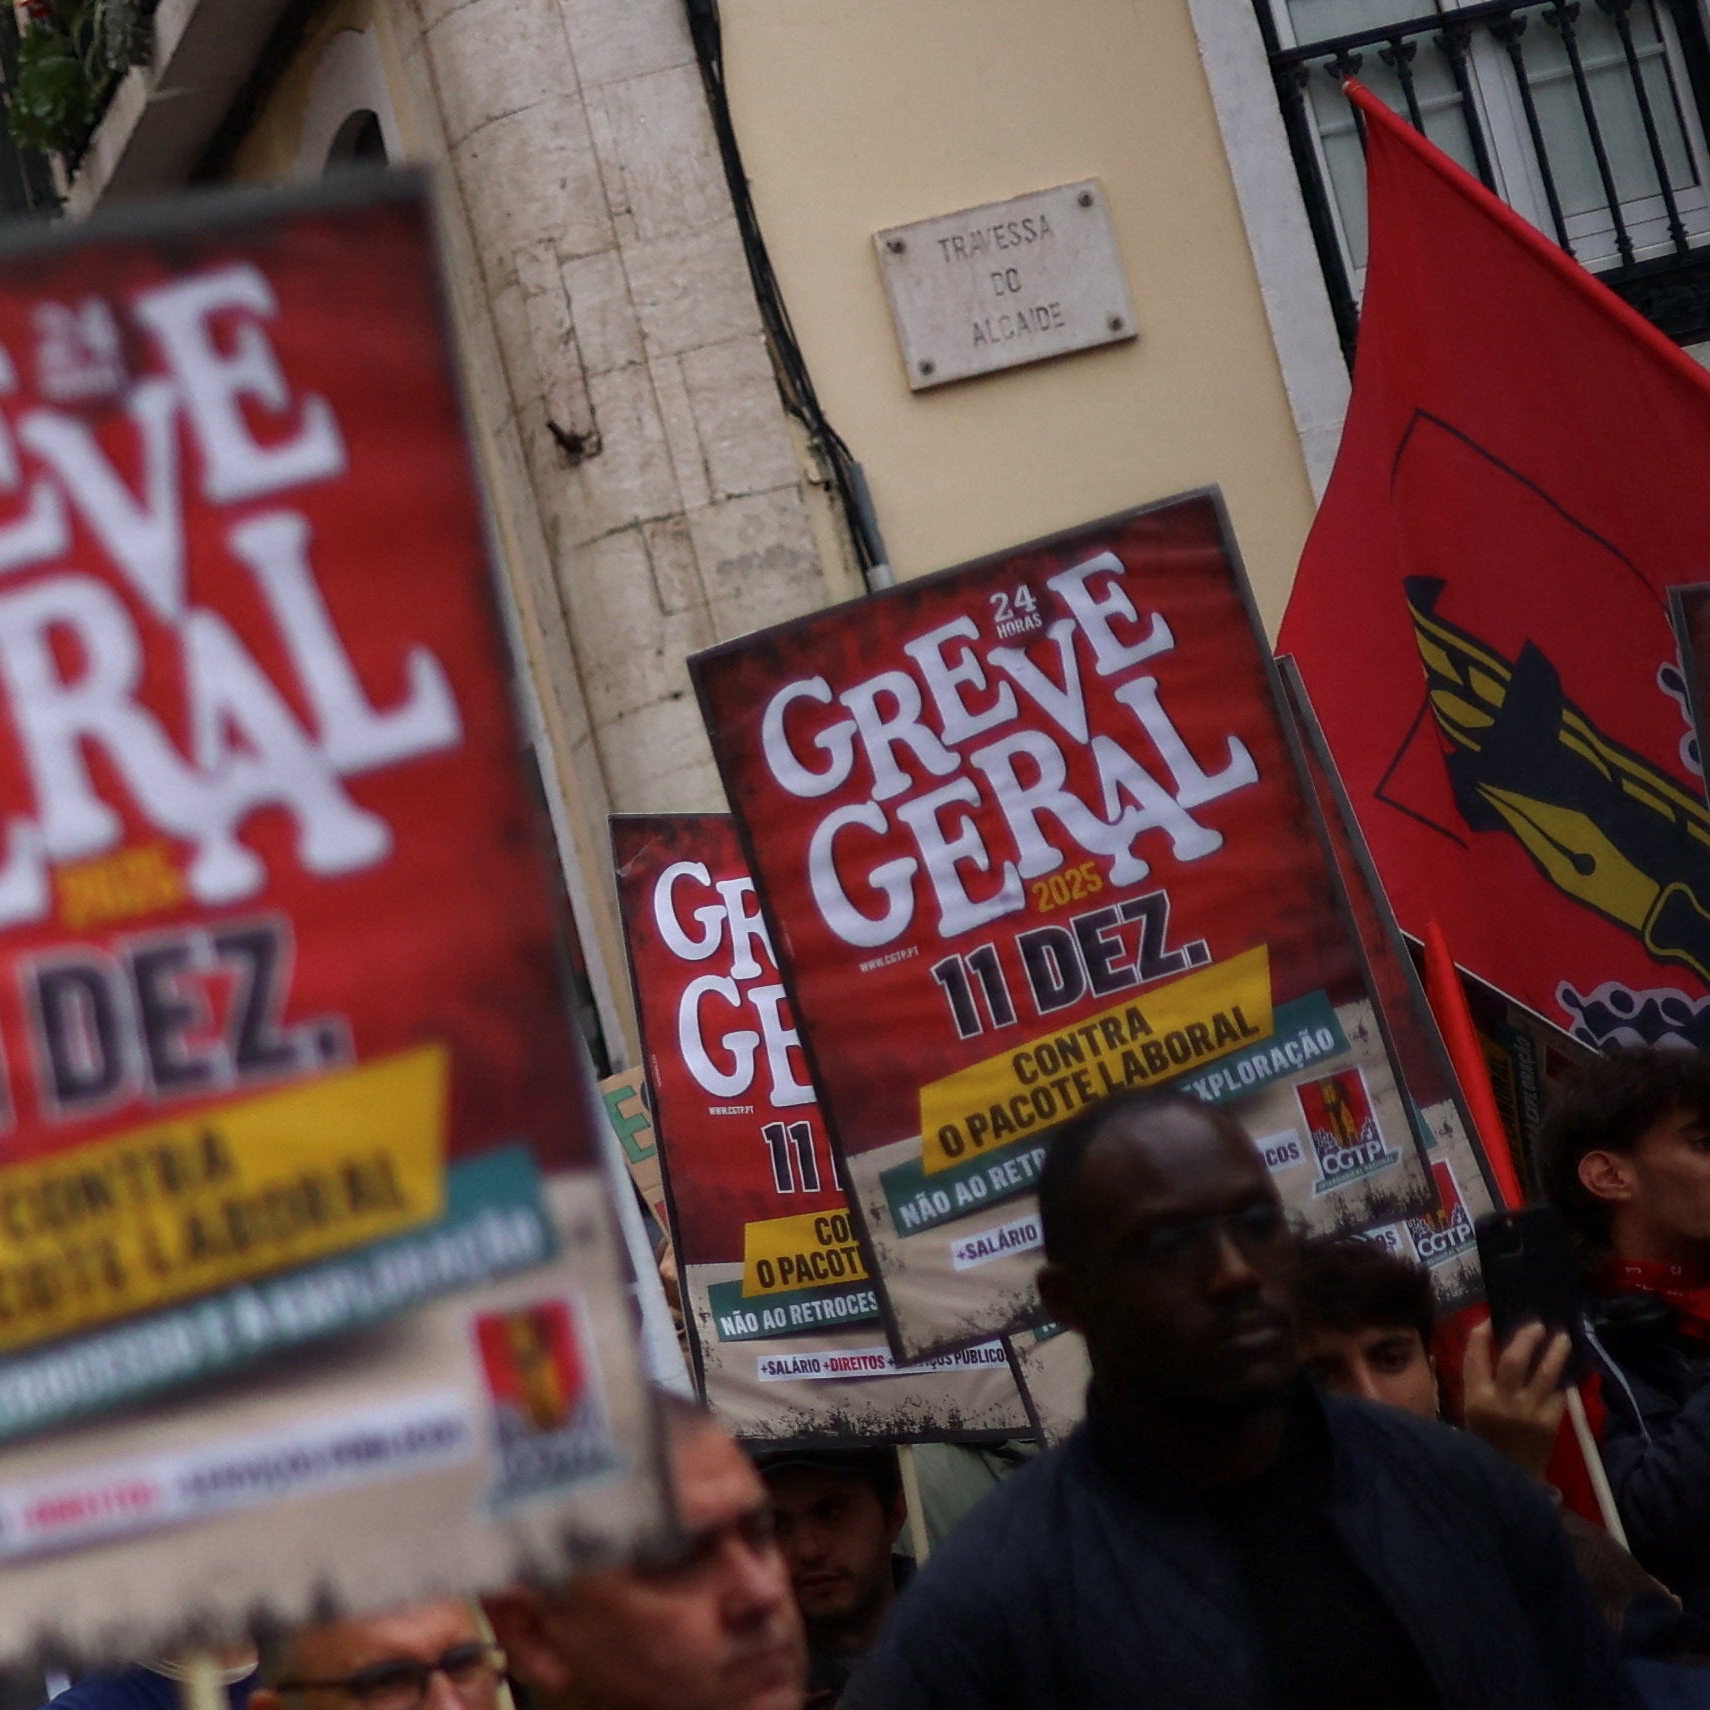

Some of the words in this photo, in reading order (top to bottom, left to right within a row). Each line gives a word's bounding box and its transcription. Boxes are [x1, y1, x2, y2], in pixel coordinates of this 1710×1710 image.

[937, 214, 1054, 264] TRAVESSA
[990, 268, 1020, 297] DO
[972, 302, 1065, 348] ALCAIDE
[989, 584, 1037, 623] 24
[996, 613, 1042, 640] HORAS
[761, 552, 1175, 800] GREVE
[809, 677, 1258, 948] GERAL
[1032, 864, 1102, 913] 2025
[931, 942, 1018, 1040] 11
[1017, 890, 1210, 1014] DEZ.
[27, 909, 355, 1117] DEZ.
[1012, 1006, 1153, 1085] CONTRA
[938, 1125, 964, 1158] O
[965, 1071, 1100, 1147] PACOTE
[1099, 1005, 1260, 1092] LABORAL
[761, 1120, 822, 1194] 11
[1321, 1141, 1381, 1175] CGTP
[144, 1153, 409, 1284] LABORAL
[899, 1192, 950, 1228] NÃO
[955, 1177, 987, 1204] AO
[957, 1223, 1038, 1261] +SALÁRIO
[1417, 1223, 1472, 1258] CGTP
[757, 1259, 775, 1289] O
[720, 1308, 759, 1337] NÃO
[762, 1307, 787, 1331] AO
[791, 1290, 878, 1325] RETROCES
[761, 1356, 821, 1377] +SALÁRIO
[823, 1354, 885, 1373] +DIREITOS
